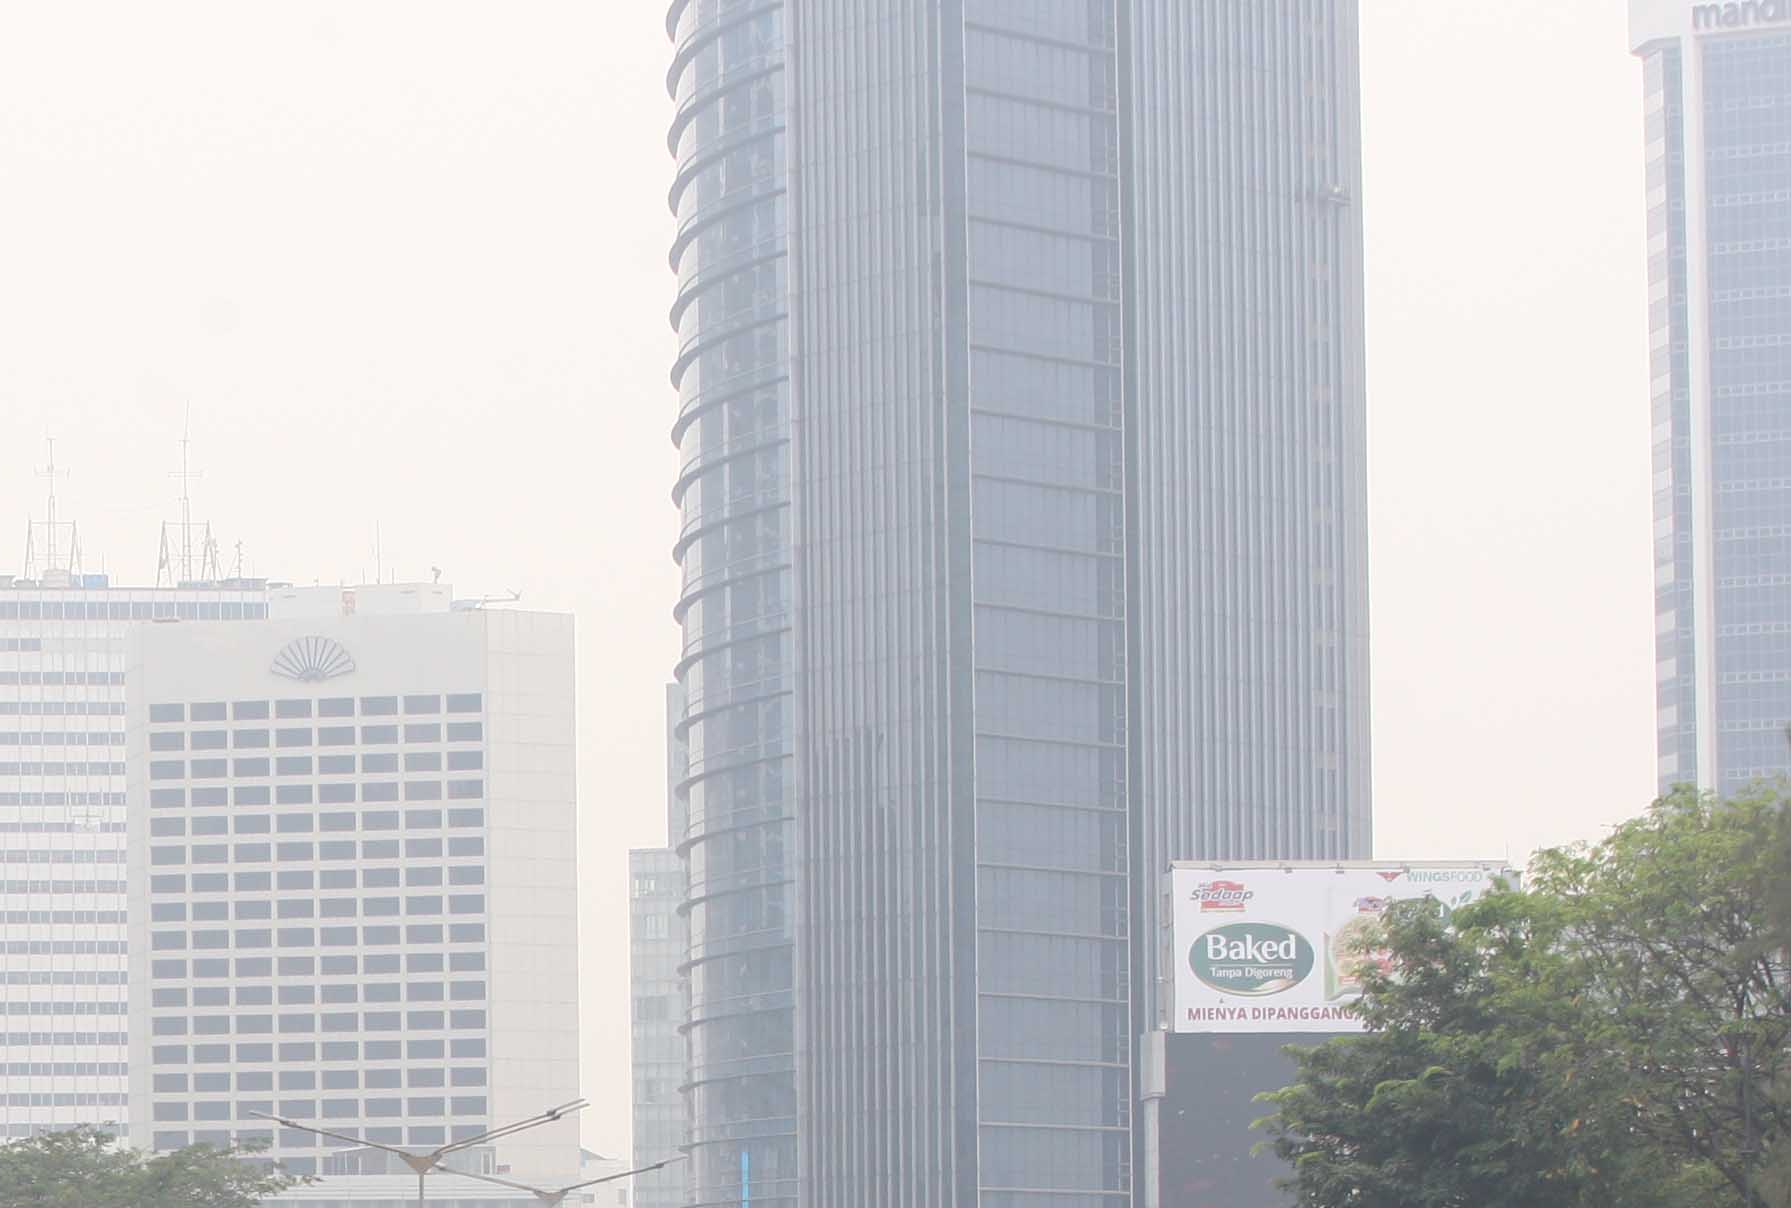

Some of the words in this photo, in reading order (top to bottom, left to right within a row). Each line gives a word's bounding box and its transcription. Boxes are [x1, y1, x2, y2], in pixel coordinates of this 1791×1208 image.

[1206, 934, 1297, 963] Baked
[1209, 967, 1242, 979] Tanpa
[1245, 967, 1293, 979] Digoreng
[1187, 1007, 1248, 1021] MIENYA
